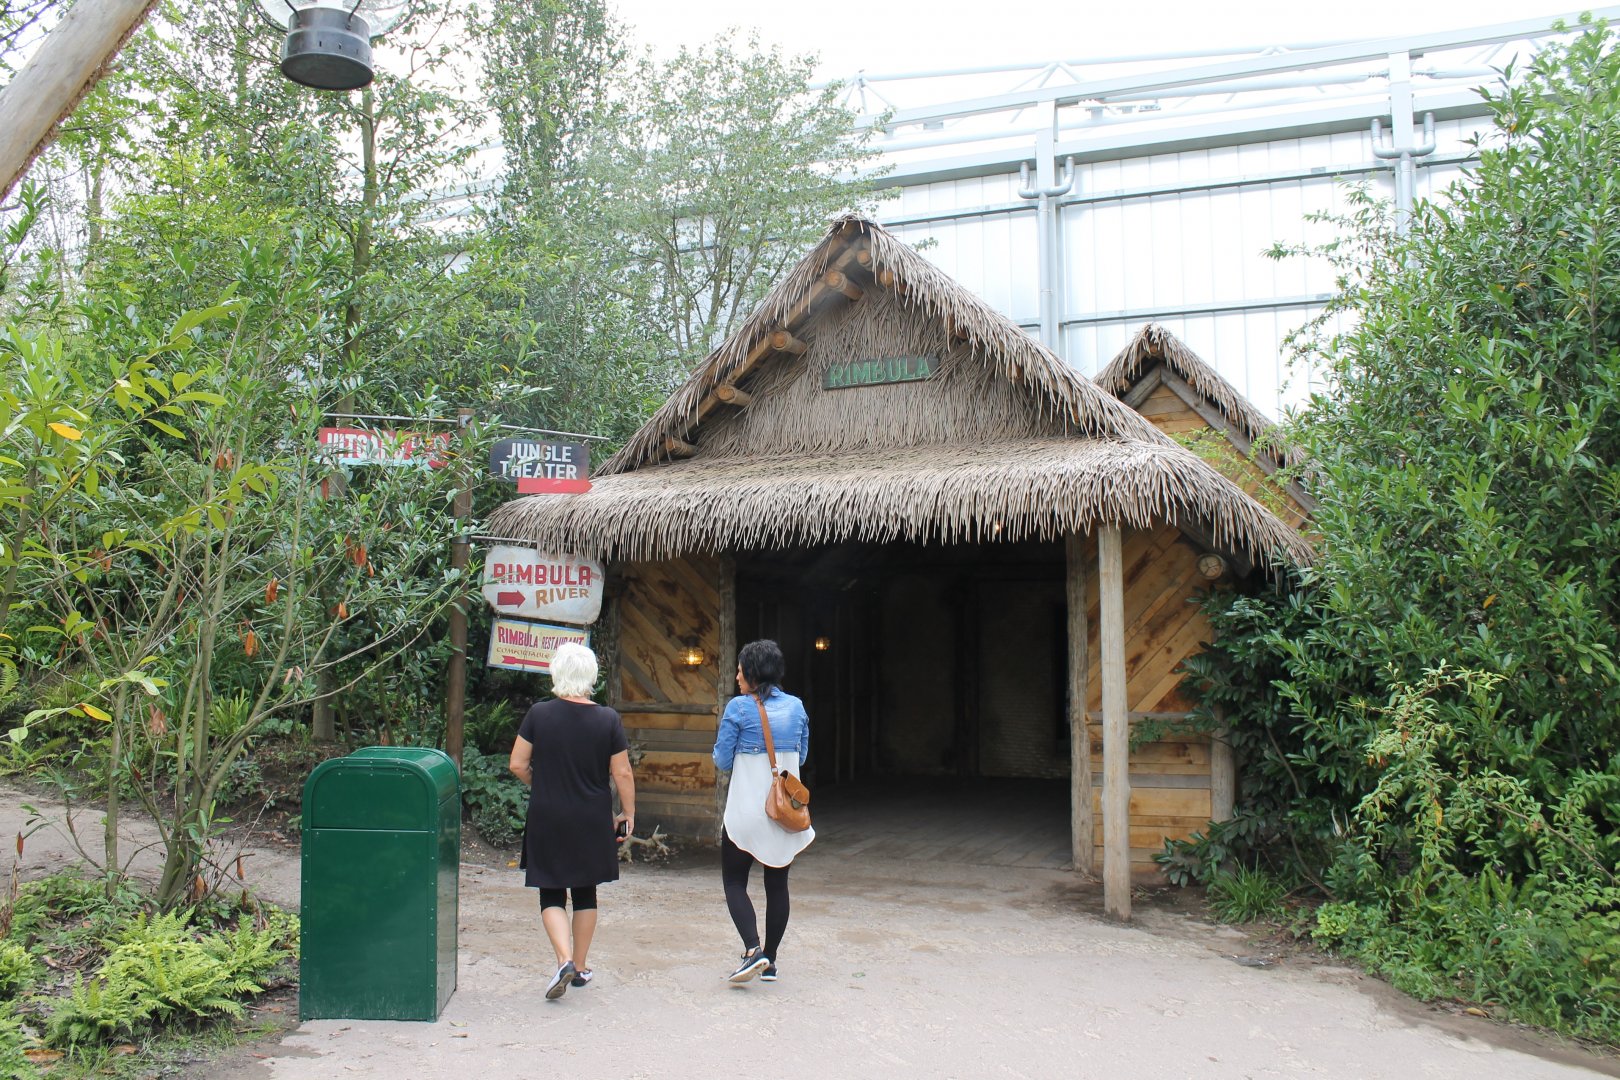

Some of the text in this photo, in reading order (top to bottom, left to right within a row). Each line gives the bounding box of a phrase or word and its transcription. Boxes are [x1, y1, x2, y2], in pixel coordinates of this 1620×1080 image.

[828, 357, 931, 387] RIMBULA
[326, 432, 406, 460] UITGA
[506, 442, 573, 463] JUNGLE
[500, 460, 577, 480] THEATER
[493, 563, 592, 586] RIMBULA
[535, 587, 590, 609] RIVER
[497, 626, 539, 649] RIMBULA
